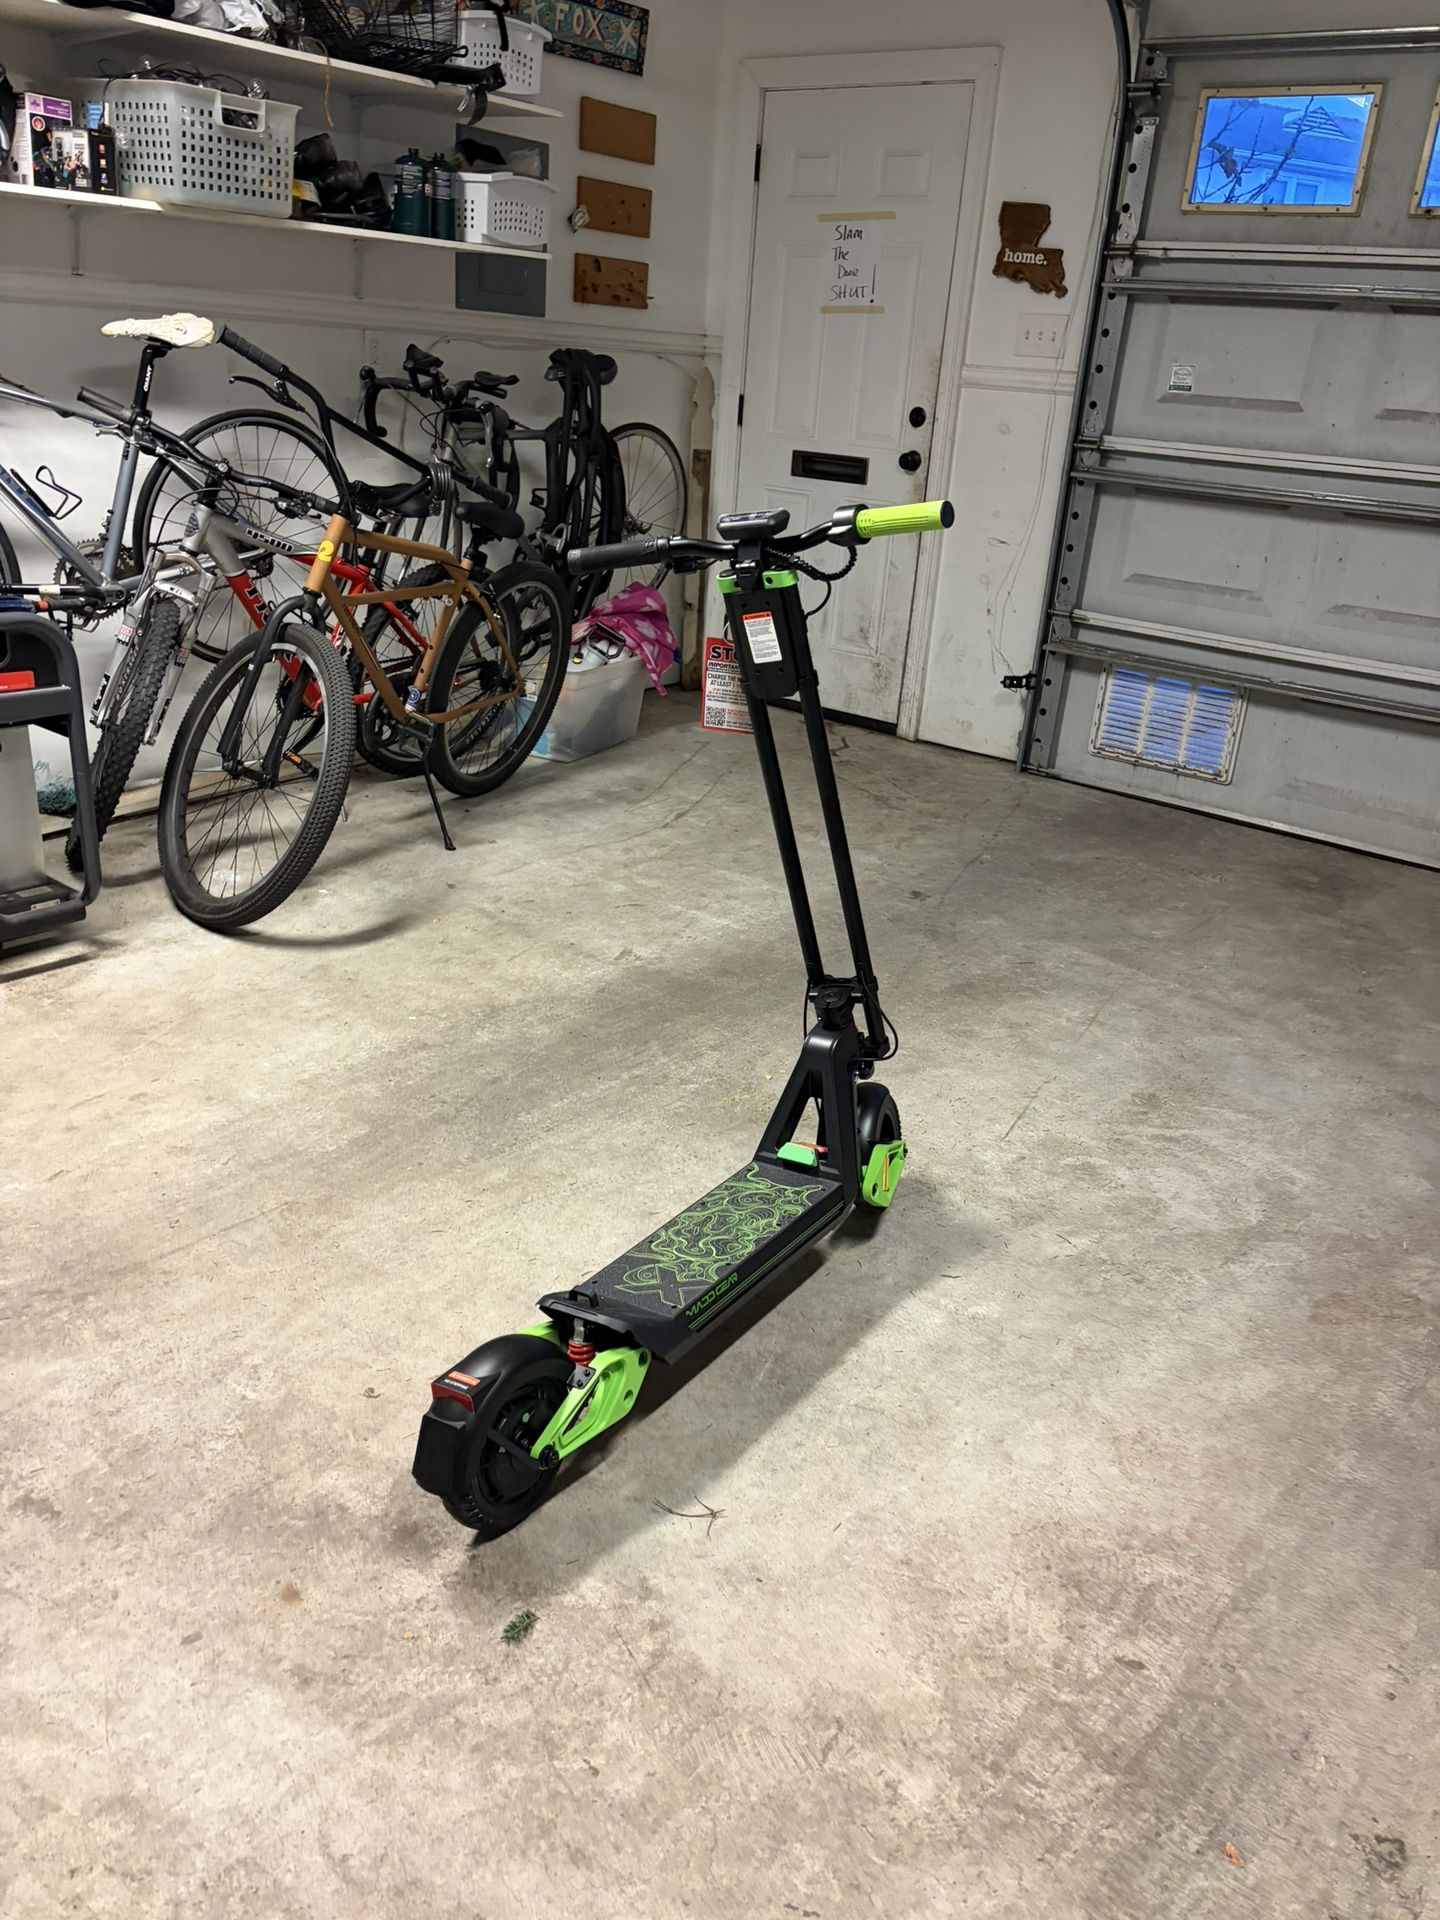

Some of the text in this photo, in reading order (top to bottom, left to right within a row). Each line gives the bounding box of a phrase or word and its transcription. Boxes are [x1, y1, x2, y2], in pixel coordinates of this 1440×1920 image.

[554, 3, 604, 41] FOX
[831, 246, 849, 261] The
[1003, 248, 1048, 265] home.
[247, 529, 294, 552] 4500
[710, 646, 739, 661] ST
[708, 661, 740, 671] IMPORTAN
